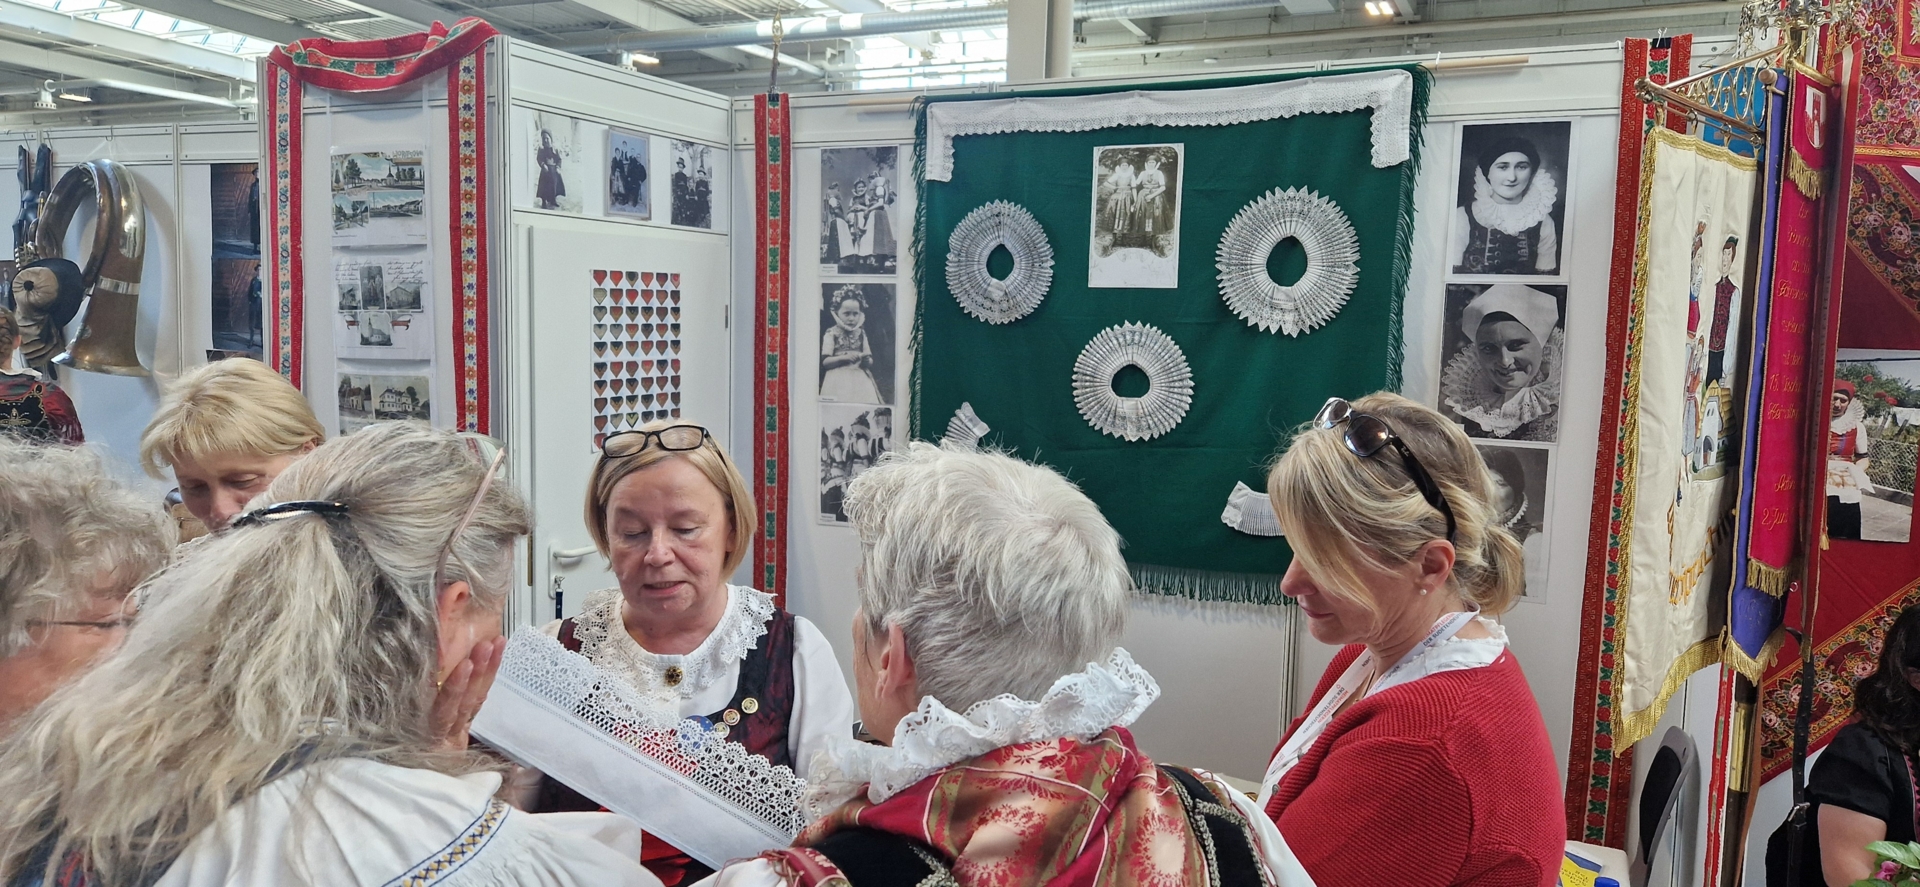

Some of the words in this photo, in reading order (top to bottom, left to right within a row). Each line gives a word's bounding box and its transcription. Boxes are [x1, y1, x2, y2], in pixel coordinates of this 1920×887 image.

[1423, 637, 1433, 647] DER
[1335, 686, 1345, 696] DER
[1301, 694, 1337, 734] SUDETENDEUTSCHEN
[1316, 689, 1349, 723] HEIMATPFLEGERIN
